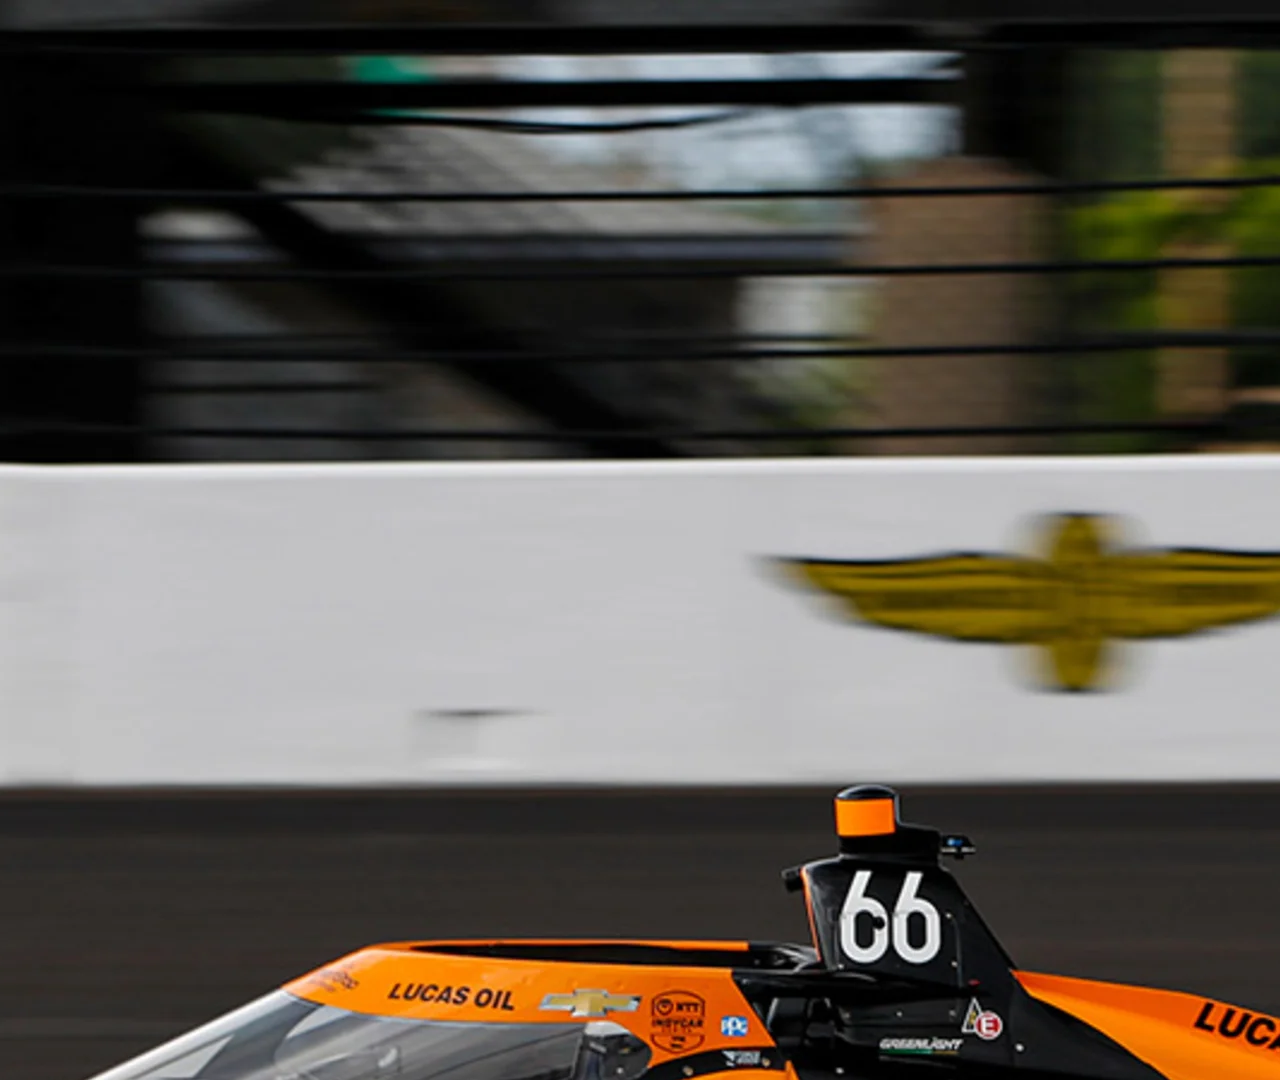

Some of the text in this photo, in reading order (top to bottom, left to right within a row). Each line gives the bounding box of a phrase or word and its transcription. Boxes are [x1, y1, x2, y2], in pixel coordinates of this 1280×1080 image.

[839, 870, 942, 965] 66
[387, 981, 516, 1012] LUCAS OIL
